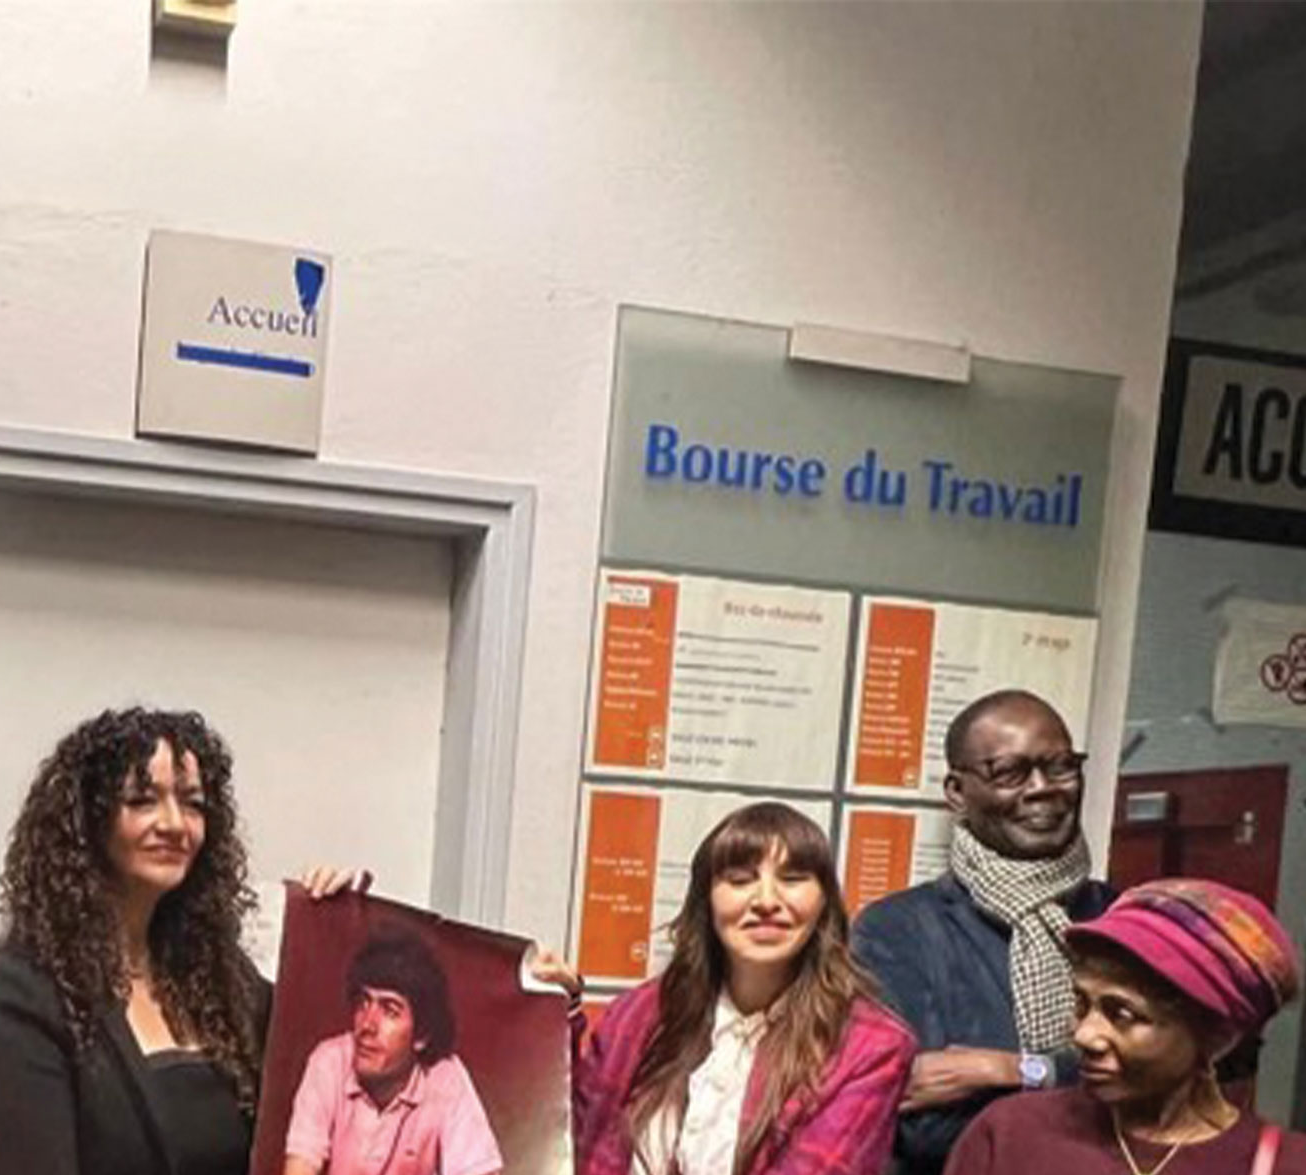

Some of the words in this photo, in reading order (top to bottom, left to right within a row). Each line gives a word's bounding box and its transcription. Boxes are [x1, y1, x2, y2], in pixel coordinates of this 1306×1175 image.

[645, 423, 826, 497] Bourse
[844, 449, 907, 507] du
[922, 460, 1083, 527] Travail
